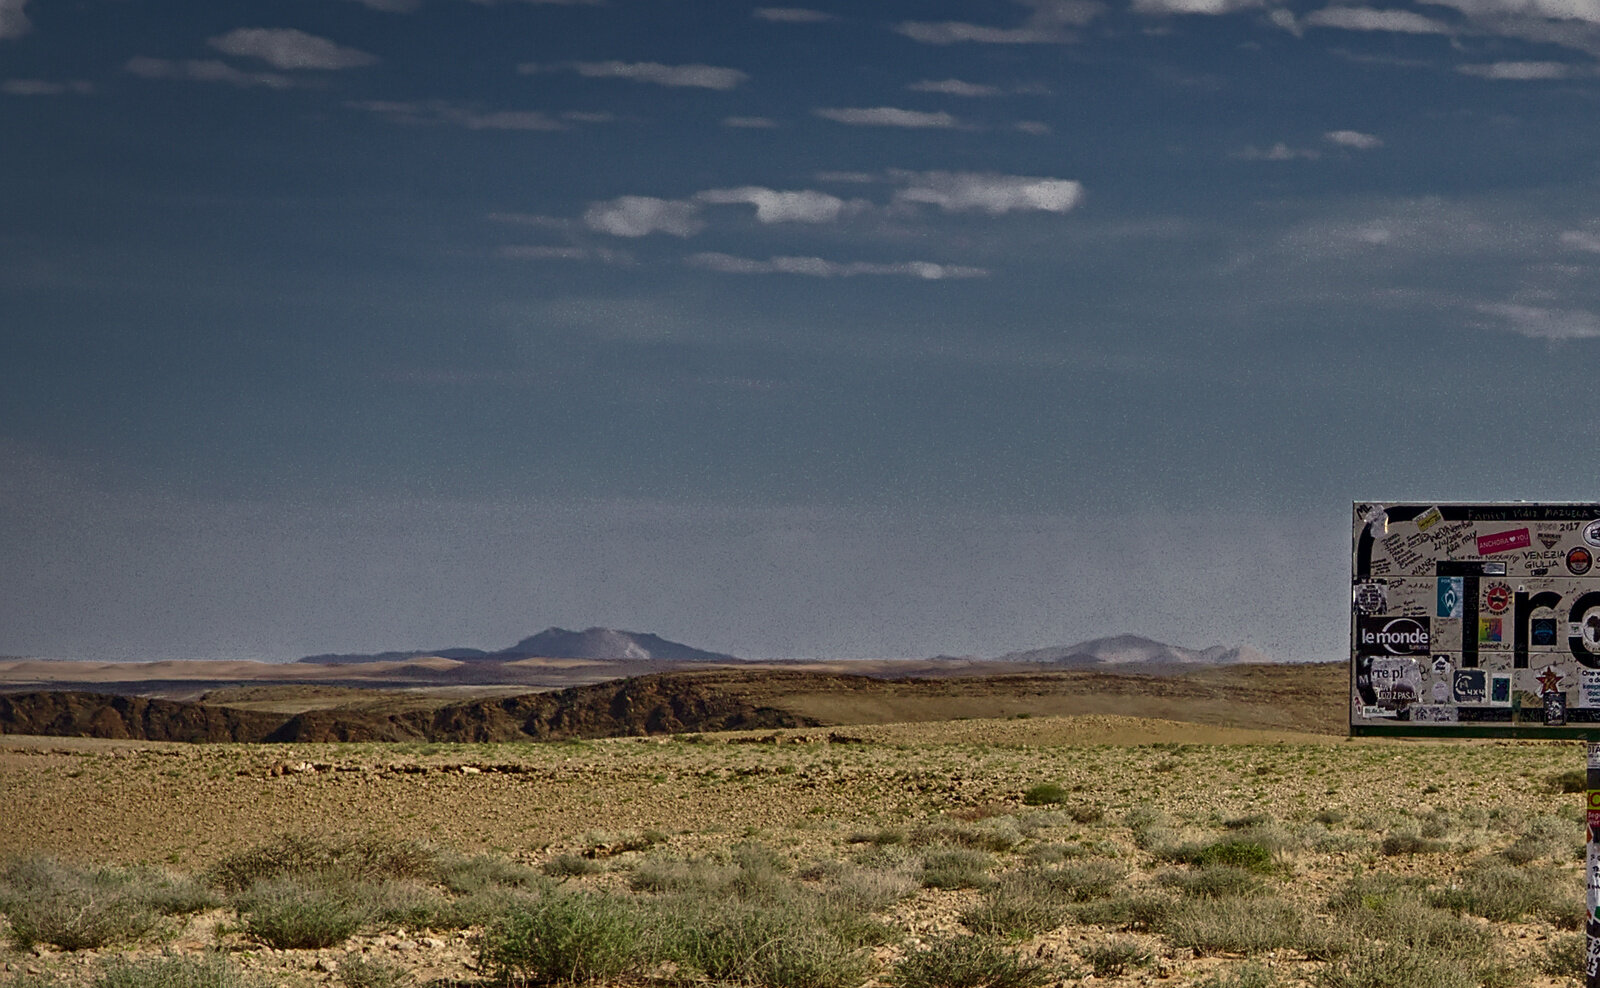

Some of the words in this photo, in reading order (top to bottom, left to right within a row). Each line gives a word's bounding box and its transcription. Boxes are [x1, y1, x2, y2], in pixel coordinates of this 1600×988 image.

[1522, 551, 1566, 560] VENEZIA
[1524, 560, 1560, 569] GIULIA
[1362, 628, 1375, 644] le
[1376, 628, 1429, 644] monde
